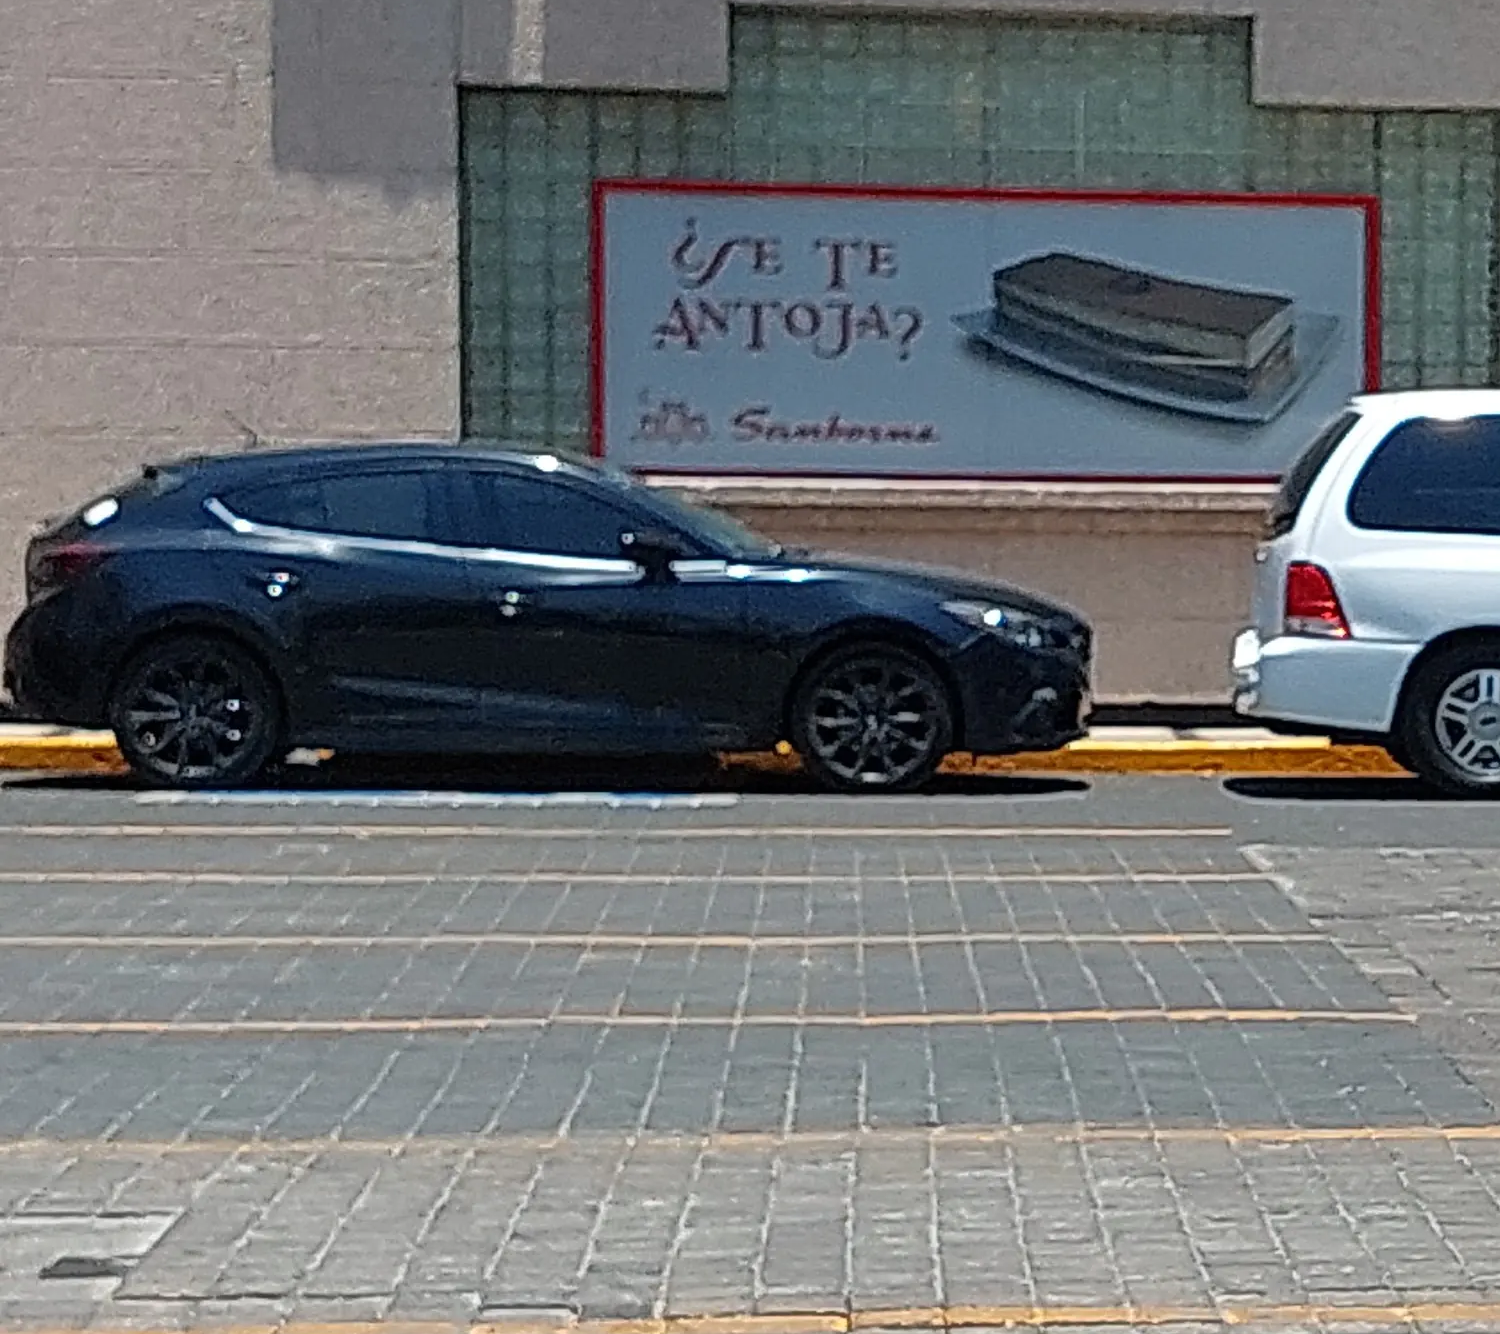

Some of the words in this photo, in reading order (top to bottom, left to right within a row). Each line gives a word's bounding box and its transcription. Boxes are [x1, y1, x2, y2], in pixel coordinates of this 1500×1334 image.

[814, 236, 897, 290] TE
[653, 297, 923, 361] ANTOJA?
[731, 404, 938, 443] Sanborns
